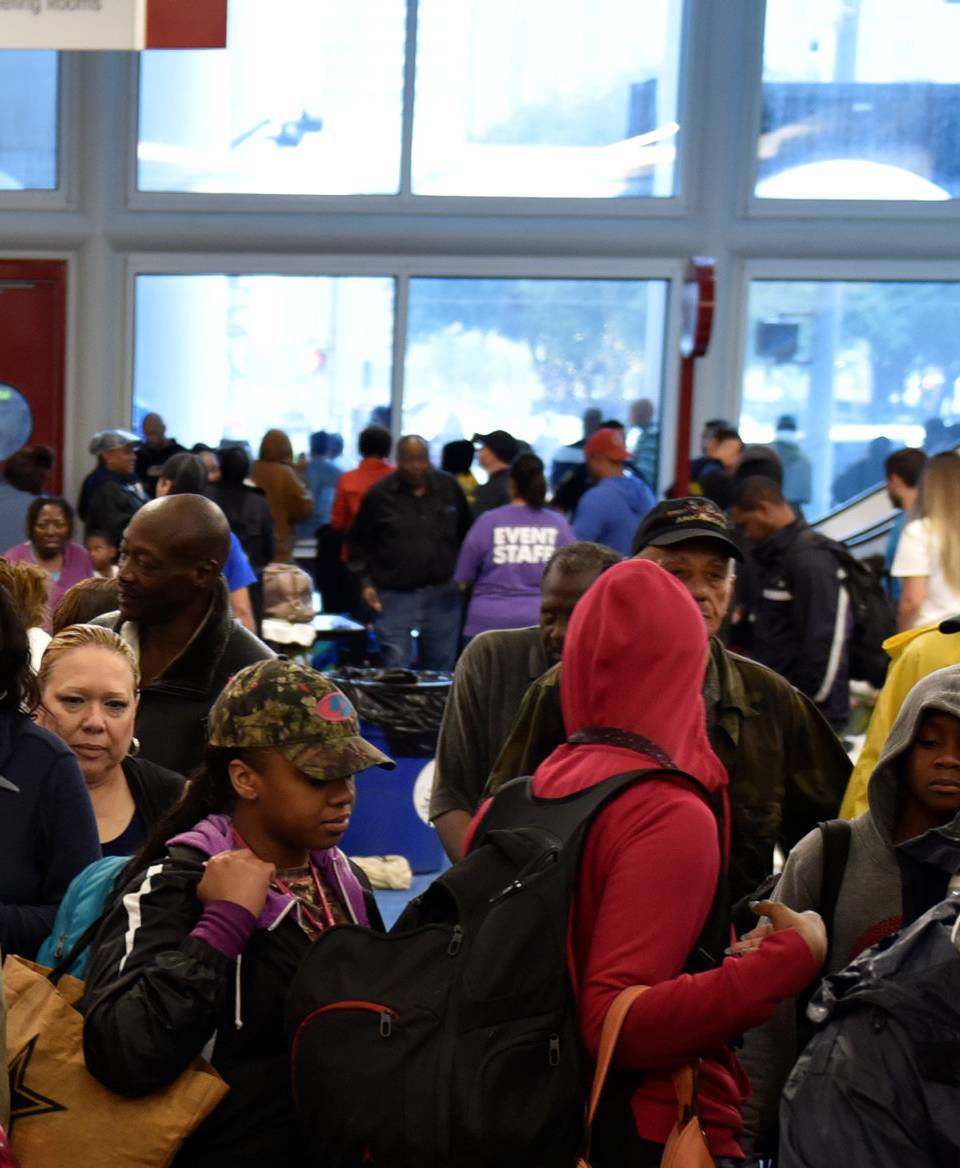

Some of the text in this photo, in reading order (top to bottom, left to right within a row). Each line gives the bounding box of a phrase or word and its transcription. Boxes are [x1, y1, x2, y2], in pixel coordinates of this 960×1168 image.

[46, 0, 102, 11] Rooms
[493, 526, 558, 545] EVENT
[493, 545, 556, 564] STAFF
